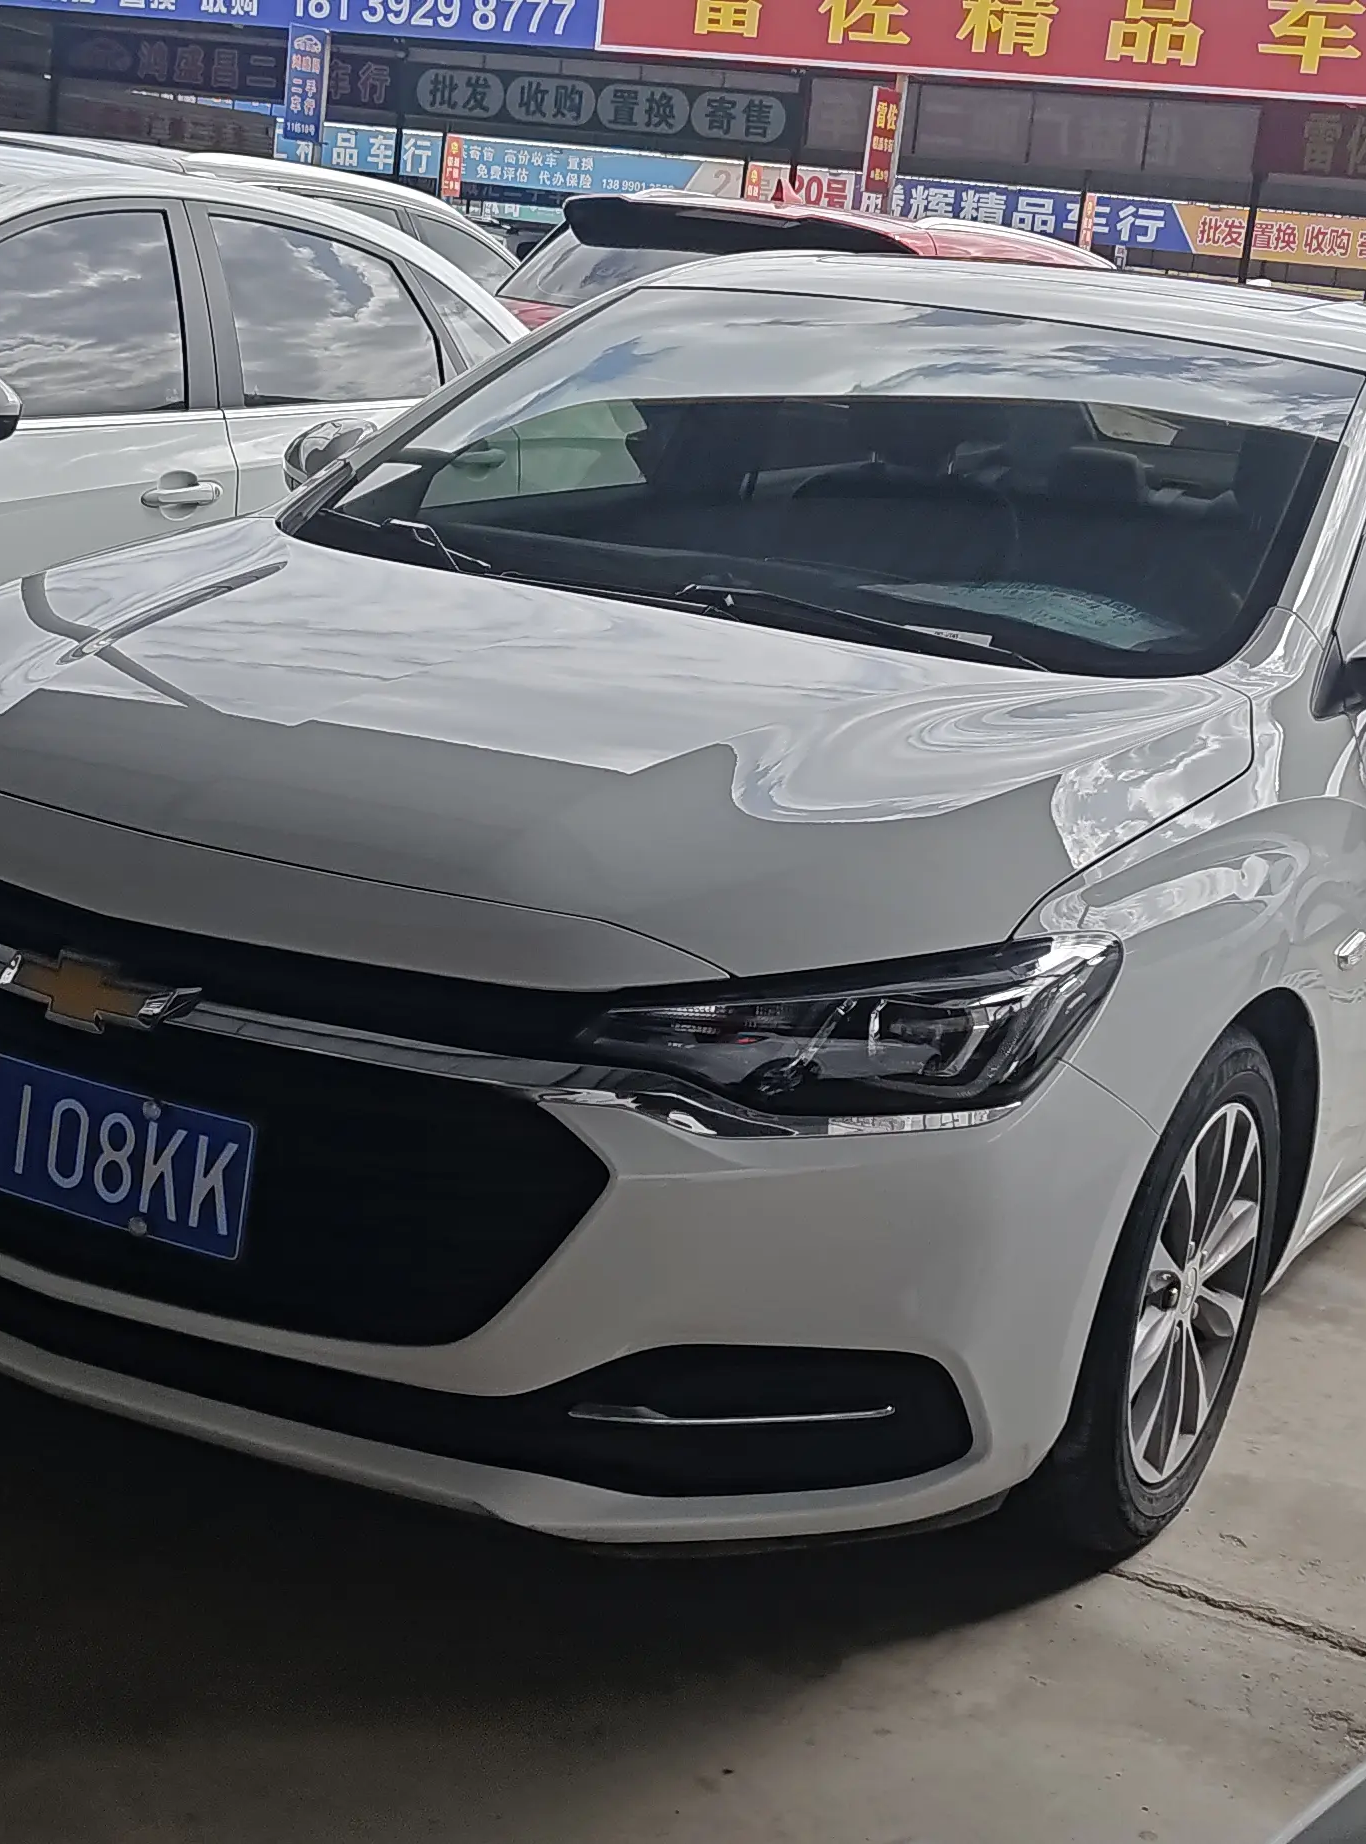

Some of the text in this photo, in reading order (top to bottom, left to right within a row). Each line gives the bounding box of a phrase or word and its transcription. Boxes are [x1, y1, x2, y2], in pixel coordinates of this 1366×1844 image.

[472, 0, 575, 35] 8777
[137, 40, 391, 104] 鸿盛昌二车行
[429, 72, 491, 113] 批发
[518, 81, 584, 122] 收购
[608, 88, 676, 130] 置换
[705, 96, 774, 139] 寄售
[476, 163, 529, 181] 免费评估
[539, 170, 593, 190] 代办保险
[602, 178, 620, 191] 138
[504, 149, 559, 169] 高价收车
[1198, 216, 1245, 248] 批发
[1252, 222, 1298, 254] 置换
[1303, 225, 1352, 257] 收购
